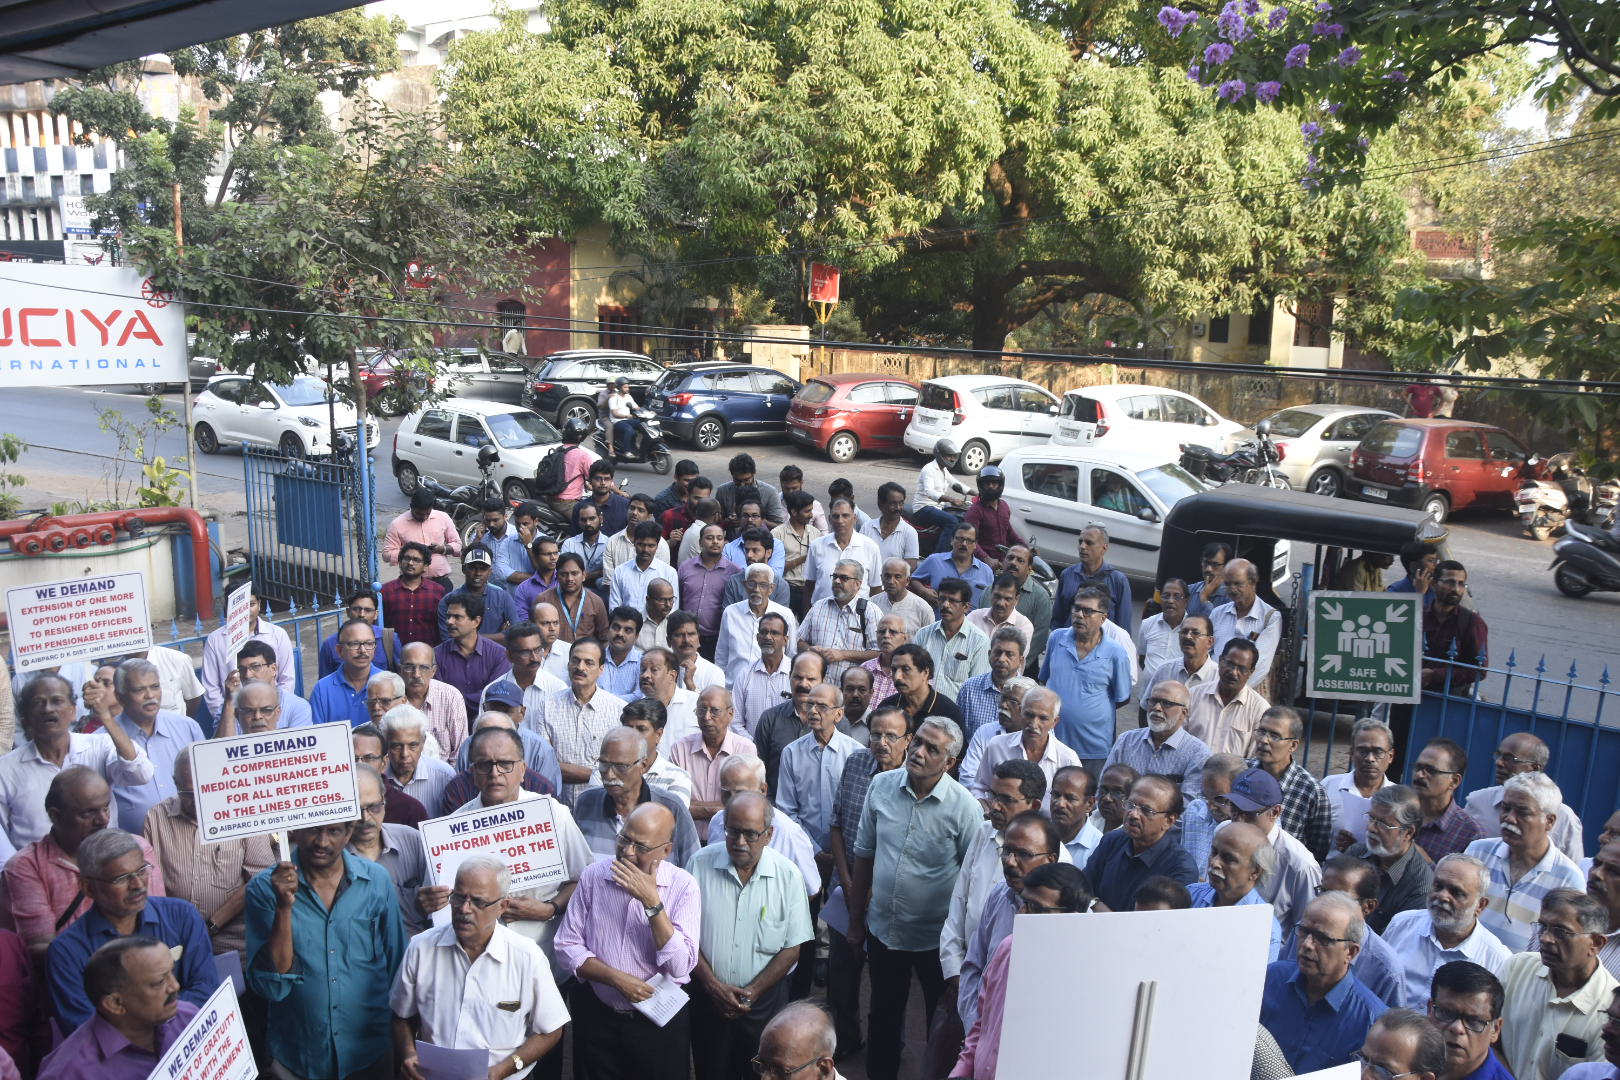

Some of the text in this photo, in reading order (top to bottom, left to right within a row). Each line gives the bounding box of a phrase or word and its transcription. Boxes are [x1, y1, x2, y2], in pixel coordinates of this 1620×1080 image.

[0, 358, 161, 370] RNATIONAL
[36, 580, 115, 599] WE DEMAND
[21, 592, 134, 615] EXTENSION OF ONE MORE
[33, 606, 127, 626] OPTION FOR PENSION
[45, 624, 89, 636] RESIGNED
[92, 617, 133, 628] OFFICERS
[18, 627, 146, 653] WITH PENSIONABLE SERVICE.
[30, 655, 59, 664] AIBPARC
[108, 639, 145, 650] MANGALORE
[1349, 668, 1376, 678] SAFE
[1317, 679, 1410, 693] ASSEMBLY POINT
[226, 736, 317, 758] WE DEMAND
[222, 752, 327, 776] A COMPREHENSIVE
[201, 763, 350, 793] MEDICAL INSURANCE PLAN
[227, 781, 329, 804] FOR ALL RETIREES
[214, 792, 345, 820] ON THE LINES OF CGHS.
[220, 822, 251, 832] AIBPARC
[268, 816, 286, 825] DIST.
[308, 806, 353, 818] MANGALORE
[449, 810, 525, 834] WE DEMAND
[432, 822, 553, 856] UNIFORM WELFARE
[528, 839, 555, 851] THE
[524, 869, 562, 882] MANGALORE
[168, 1054, 183, 1078] WE
[183, 1010, 218, 1059] DEMAND
[194, 1011, 235, 1070] OF GRATUITY
[201, 1036, 232, 1080] WITH THE
